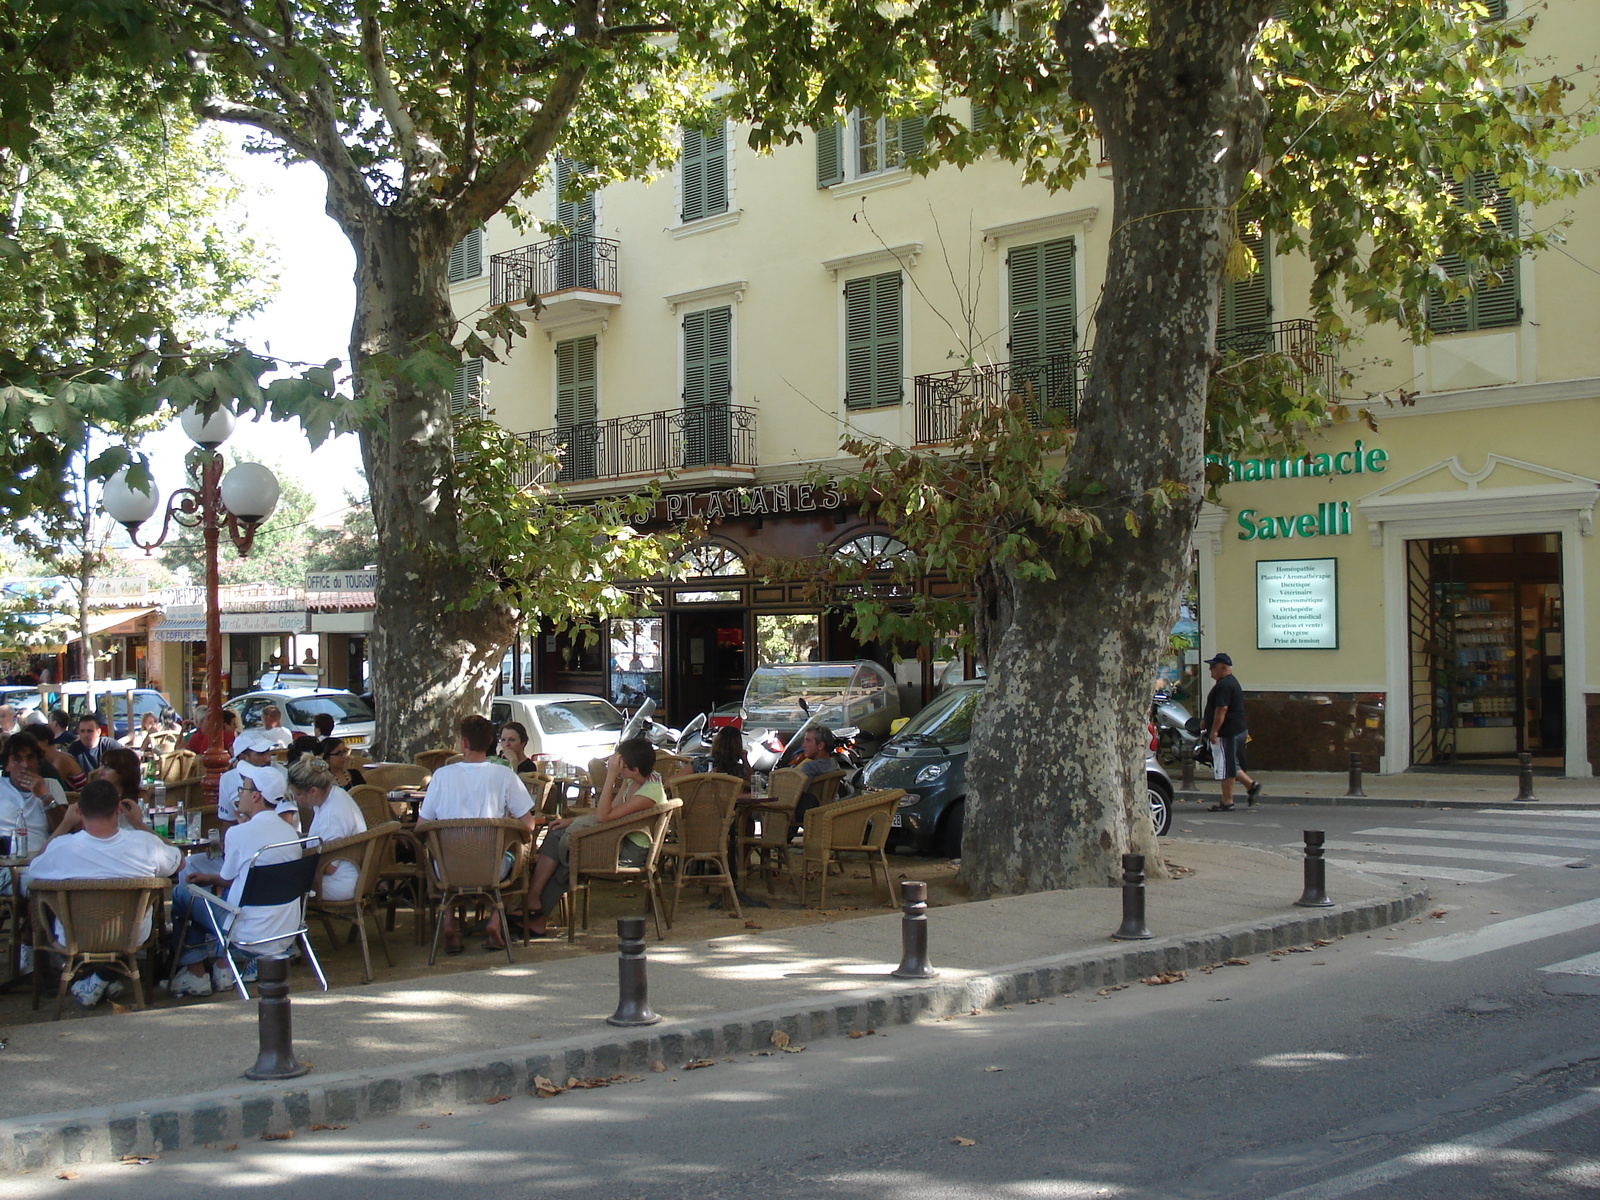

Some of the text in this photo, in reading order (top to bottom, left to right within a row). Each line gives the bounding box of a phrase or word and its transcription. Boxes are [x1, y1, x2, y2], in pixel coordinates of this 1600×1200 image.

[666, 480, 842, 522] PLATANES
[1237, 500, 1352, 541] Savelli
[1276, 565, 1316, 573] Homéopathie
[1287, 572, 1332, 580] Aromathérapie
[307, 575, 330, 589] OFFICE
[333, 576, 342, 589] du
